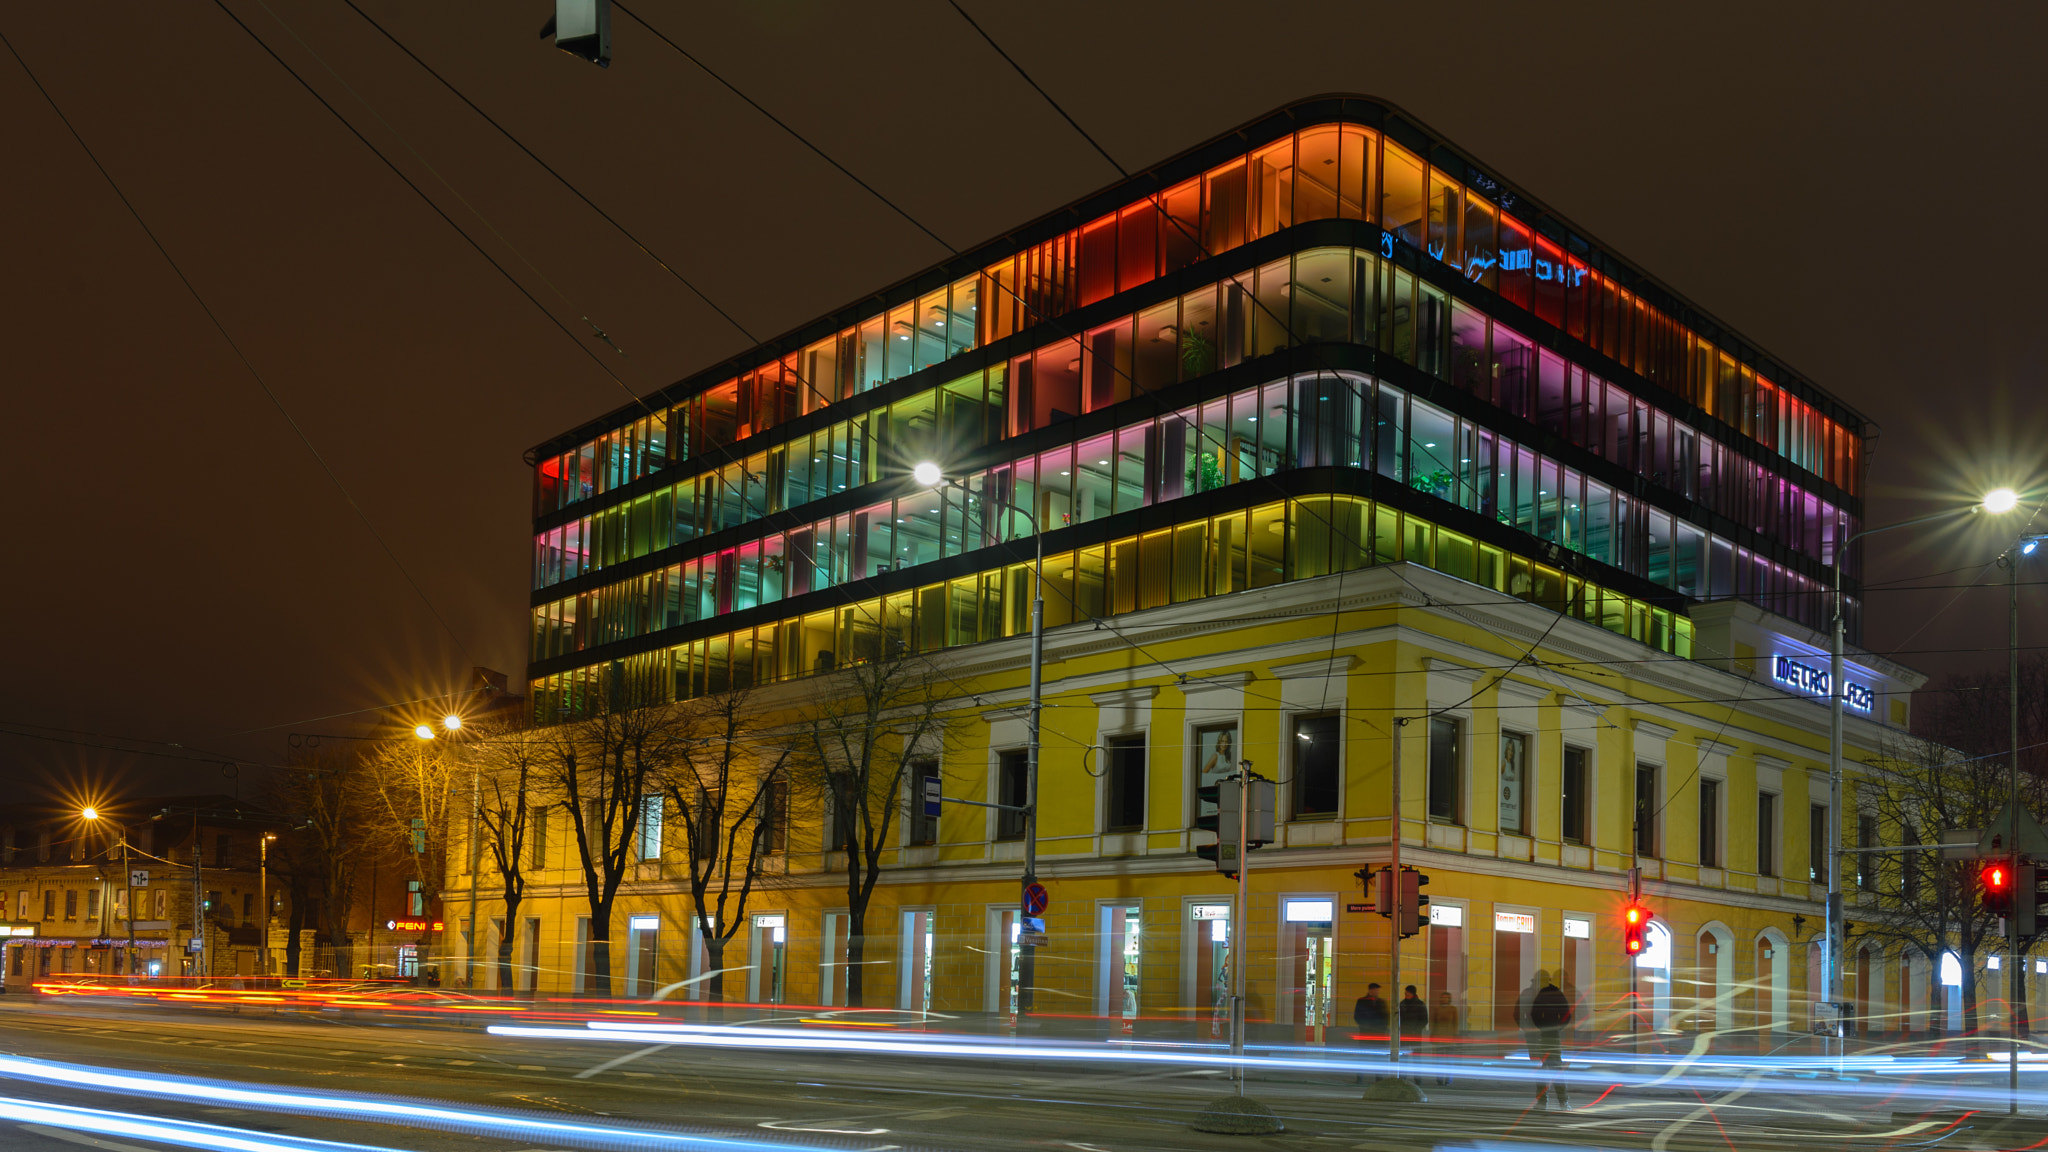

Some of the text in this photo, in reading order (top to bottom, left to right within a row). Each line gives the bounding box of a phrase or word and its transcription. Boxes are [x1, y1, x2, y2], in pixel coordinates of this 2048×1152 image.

[1774, 655, 1874, 710] METRO LAZA
[396, 922, 443, 931] FENIS
